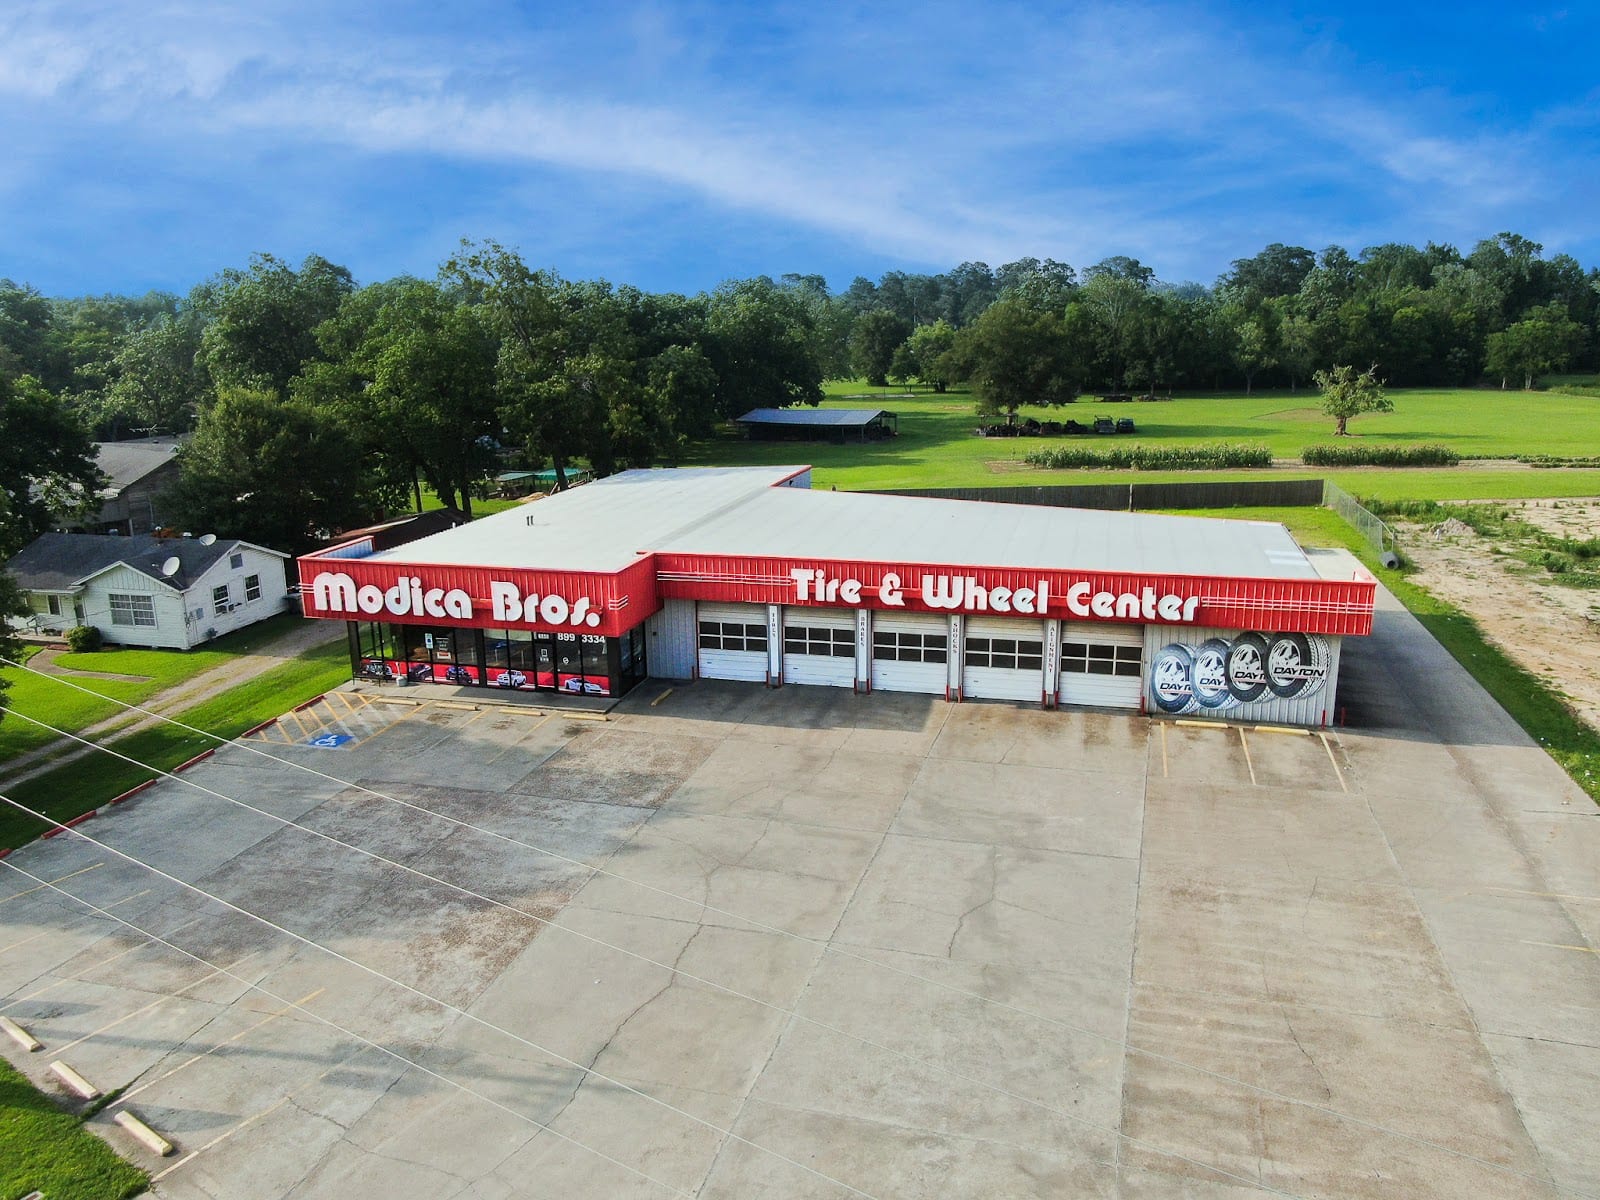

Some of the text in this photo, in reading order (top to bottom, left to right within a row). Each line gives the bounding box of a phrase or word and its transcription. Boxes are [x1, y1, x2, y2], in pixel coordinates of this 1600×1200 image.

[312, 571, 601, 628] Modica Bros.
[790, 568, 1200, 621] Tire & Wheel Center
[557, 632, 576, 642] 899
[581, 634, 606, 644] 3334
[1273, 666, 1326, 677] DAYTON
